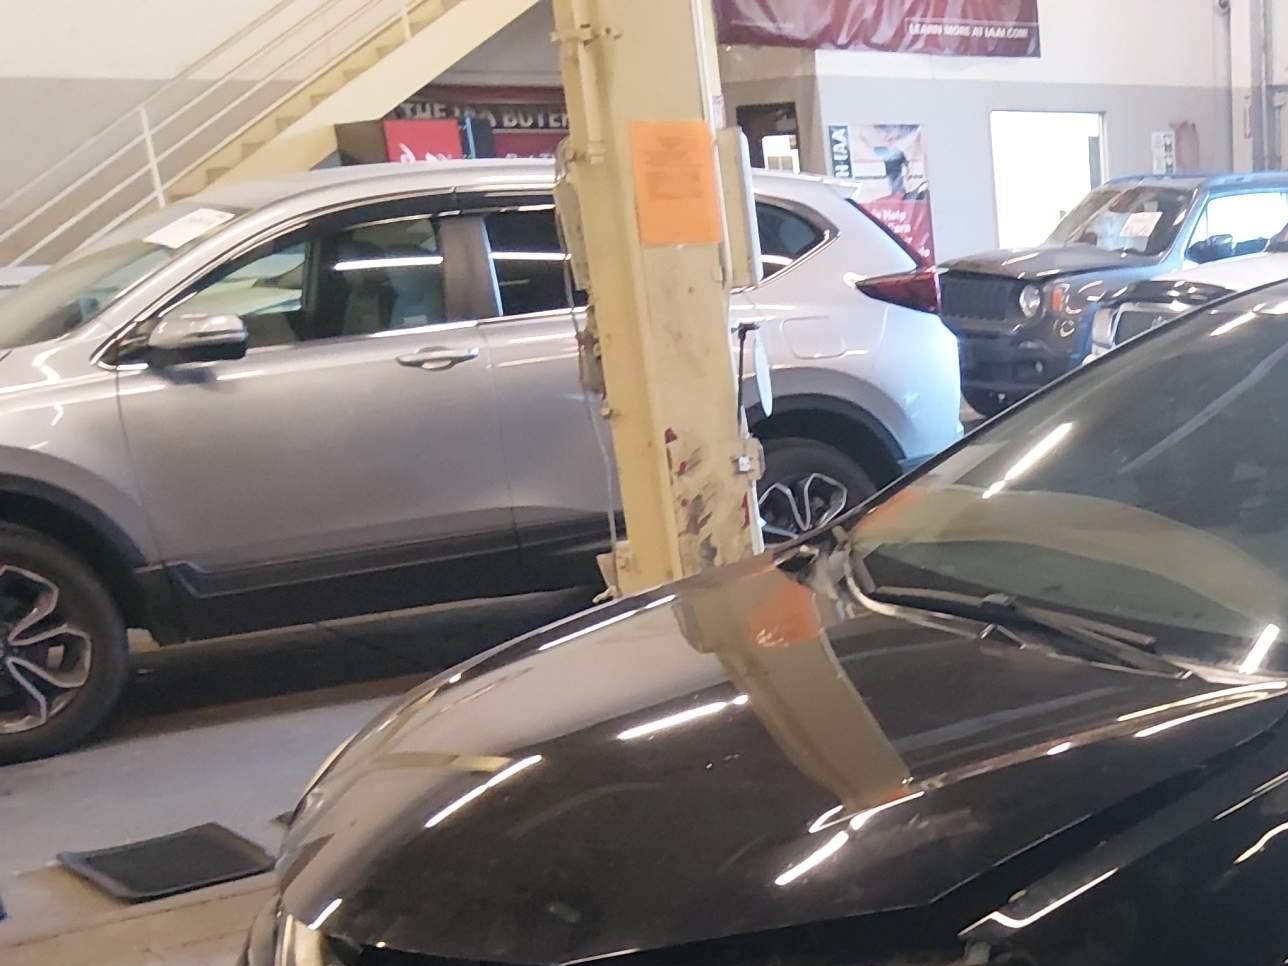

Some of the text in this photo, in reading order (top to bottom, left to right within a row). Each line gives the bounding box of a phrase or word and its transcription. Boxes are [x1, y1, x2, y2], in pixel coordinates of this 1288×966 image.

[909, 23, 942, 35] LEARN
[943, 25, 971, 37] MORE
[972, 26, 983, 38] AT
[831, 128, 849, 161] IAA
